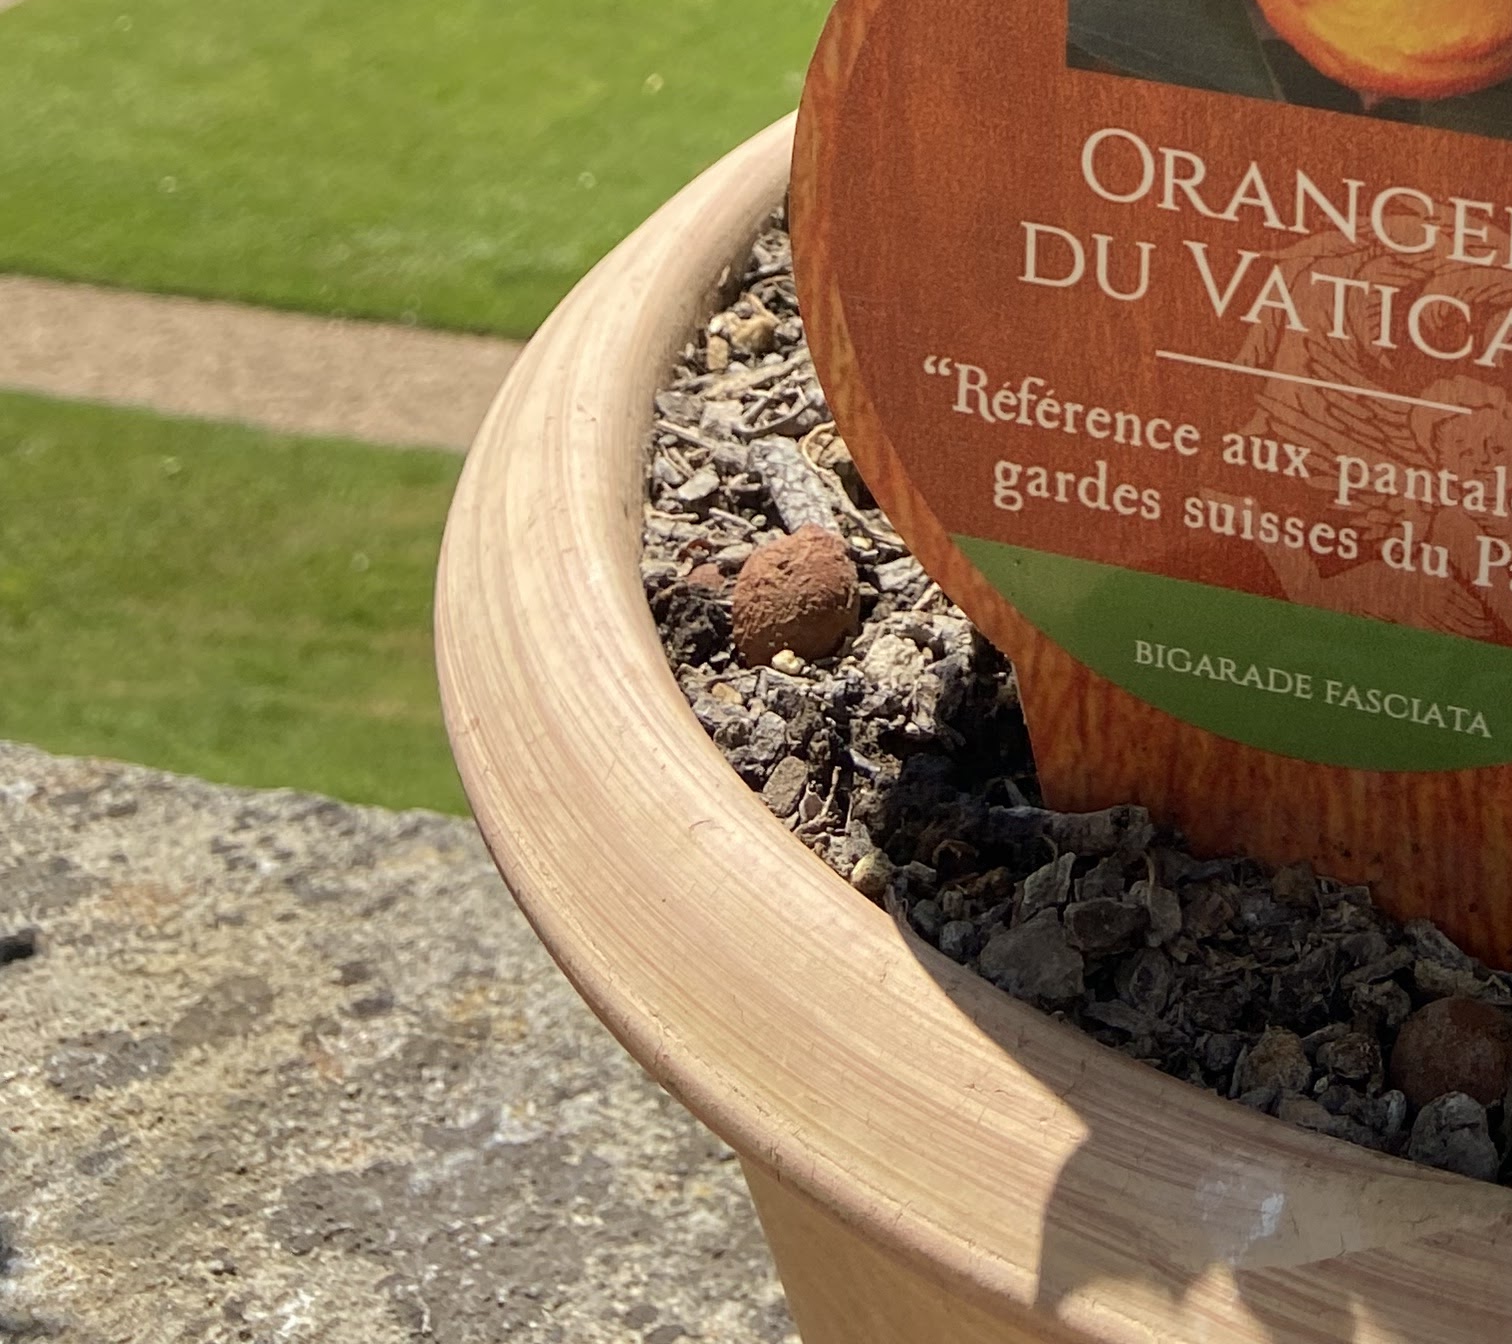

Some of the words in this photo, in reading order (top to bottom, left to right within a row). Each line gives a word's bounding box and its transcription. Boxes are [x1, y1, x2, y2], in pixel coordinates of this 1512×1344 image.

[1018, 220, 1157, 302] DU
[923, 355, 1200, 456] “Référence
[1222, 431, 1311, 479] aux
[993, 459, 1161, 520] gardes
[1183, 496, 1360, 561] suisses
[1380, 520, 1450, 578] du
[1133, 639, 1313, 700] BIGARADE
[1323, 680, 1492, 739] FASCIATA
